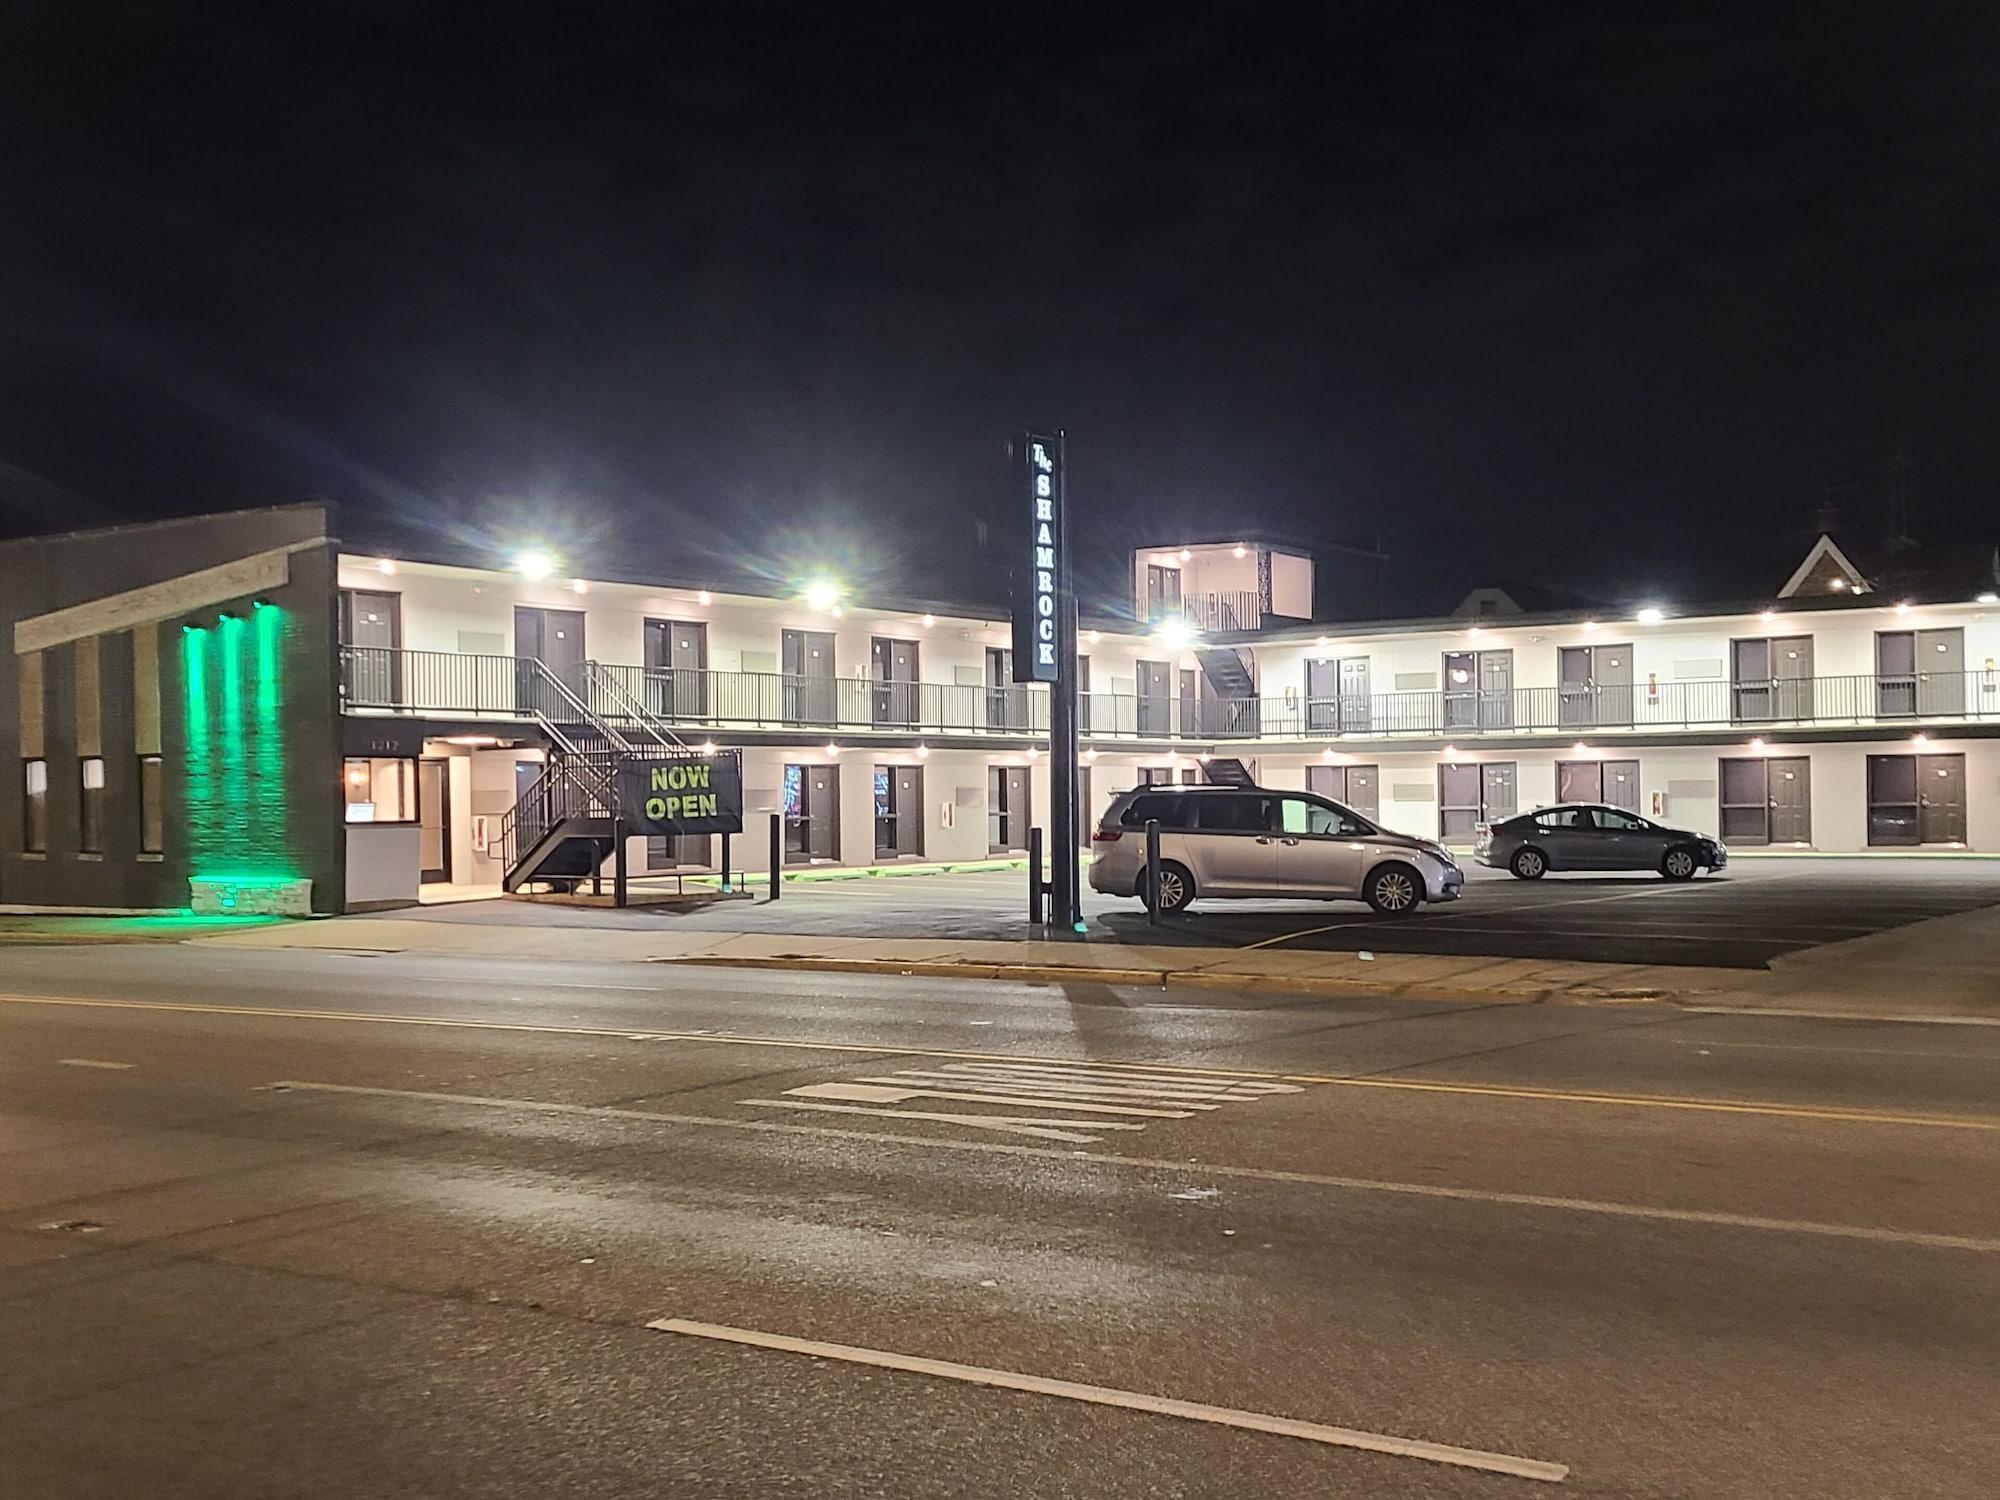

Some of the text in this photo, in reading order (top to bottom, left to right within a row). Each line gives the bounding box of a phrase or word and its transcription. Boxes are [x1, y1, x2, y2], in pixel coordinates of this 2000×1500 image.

[1032, 443, 1052, 473] The
[1036, 474, 1054, 664] SHAMROCK
[651, 765, 710, 791] NOW
[645, 793, 718, 821] OPEN
[734, 1063, 1305, 1143] ONLY
